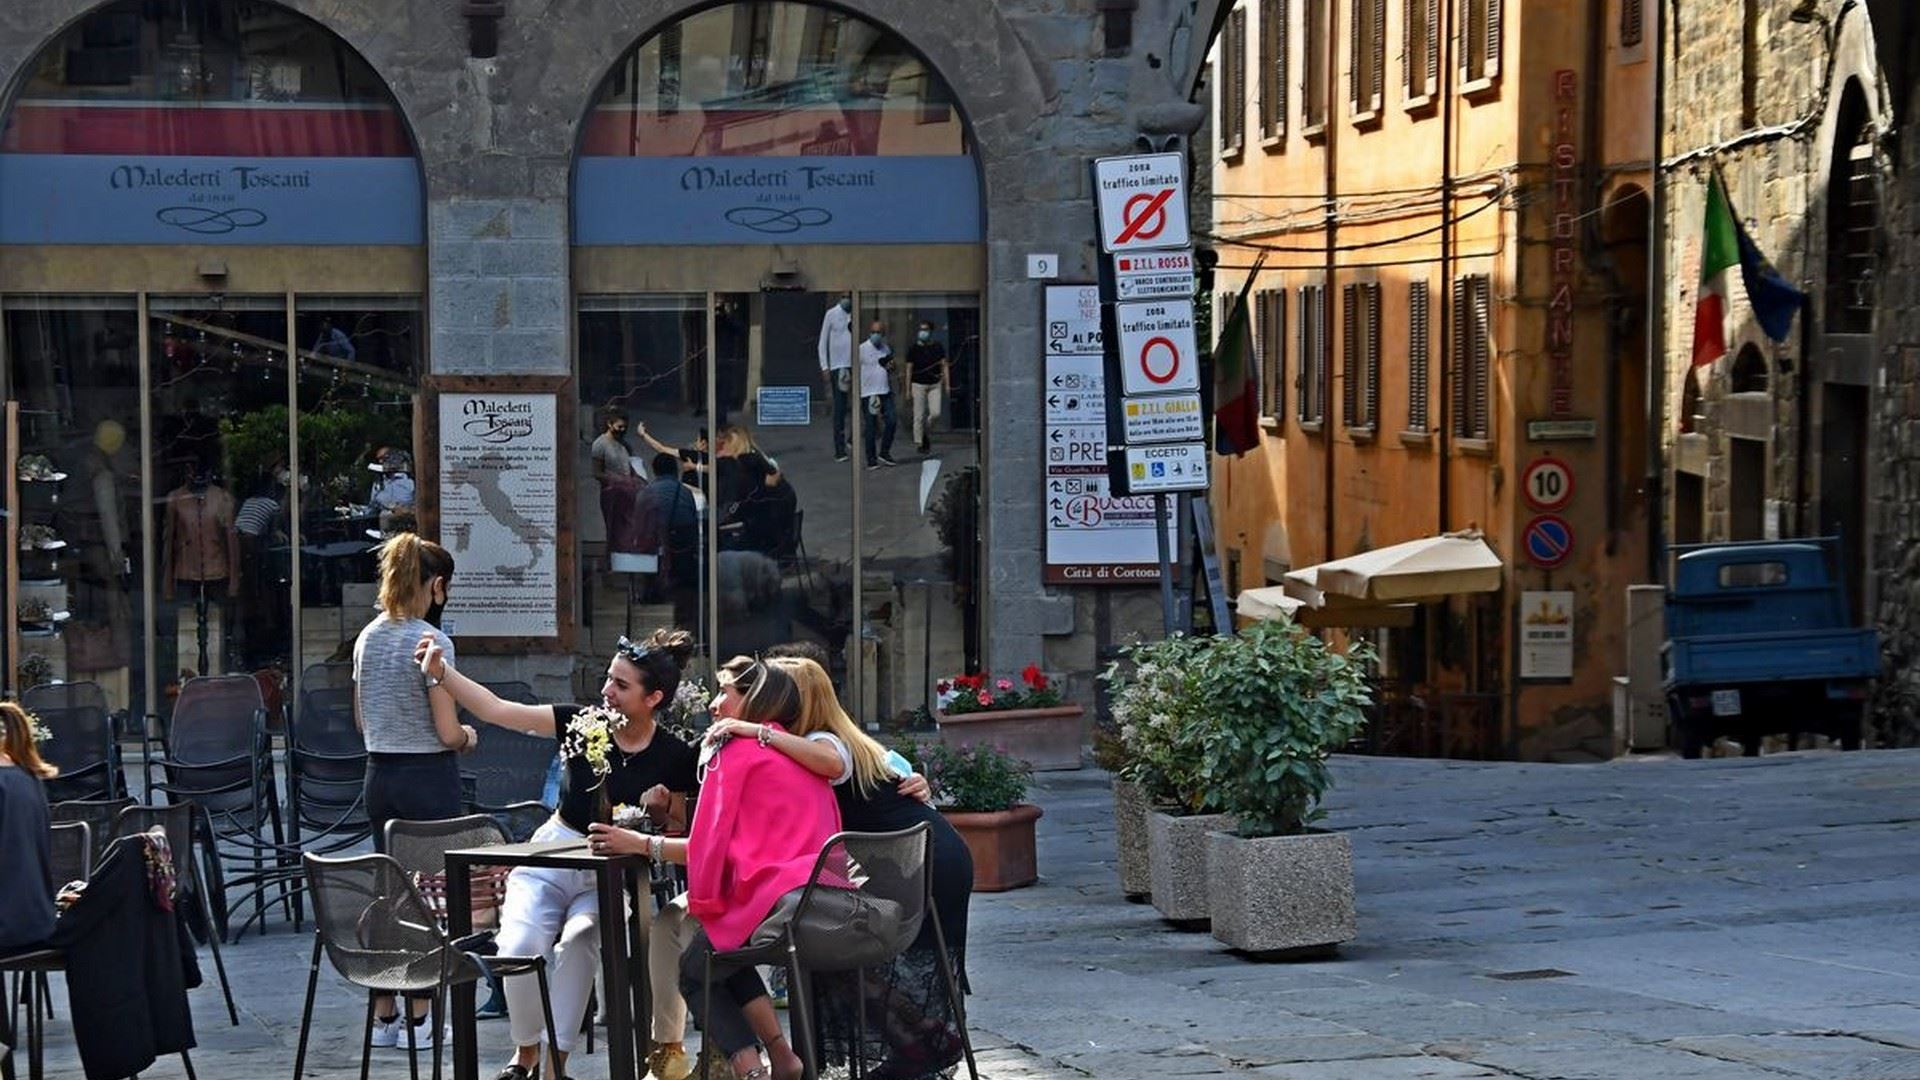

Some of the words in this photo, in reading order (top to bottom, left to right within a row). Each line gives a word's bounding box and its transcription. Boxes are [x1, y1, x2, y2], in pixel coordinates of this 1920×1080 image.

[1128, 163, 1151, 172] zona
[110, 165, 221, 189] Maledetti
[231, 167, 310, 190] Toscani
[680, 166, 788, 191] Maledetti
[797, 166, 875, 190] Toscani
[1103, 177, 1139, 189] traffico
[1141, 174, 1179, 187] limitato
[1551, 70, 1576, 416] RISTORANTE
[1038, 260, 1048, 273] 9
[1158, 256, 1190, 270] ROSSA
[1145, 307, 1166, 317] zona
[1123, 321, 1156, 333] traffico
[1156, 318, 1191, 331] limitato
[463, 399, 532, 415] Maledetti
[1164, 400, 1199, 413] GIALLA
[484, 413, 533, 429] Toscani
[1069, 442, 1104, 461] PRE
[1145, 448, 1188, 459] ECCETTO
[1535, 471, 1560, 497] 10
[1063, 566, 1093, 579] Città
[1096, 566, 1109, 579] di
[1112, 566, 1162, 578] Cortona
